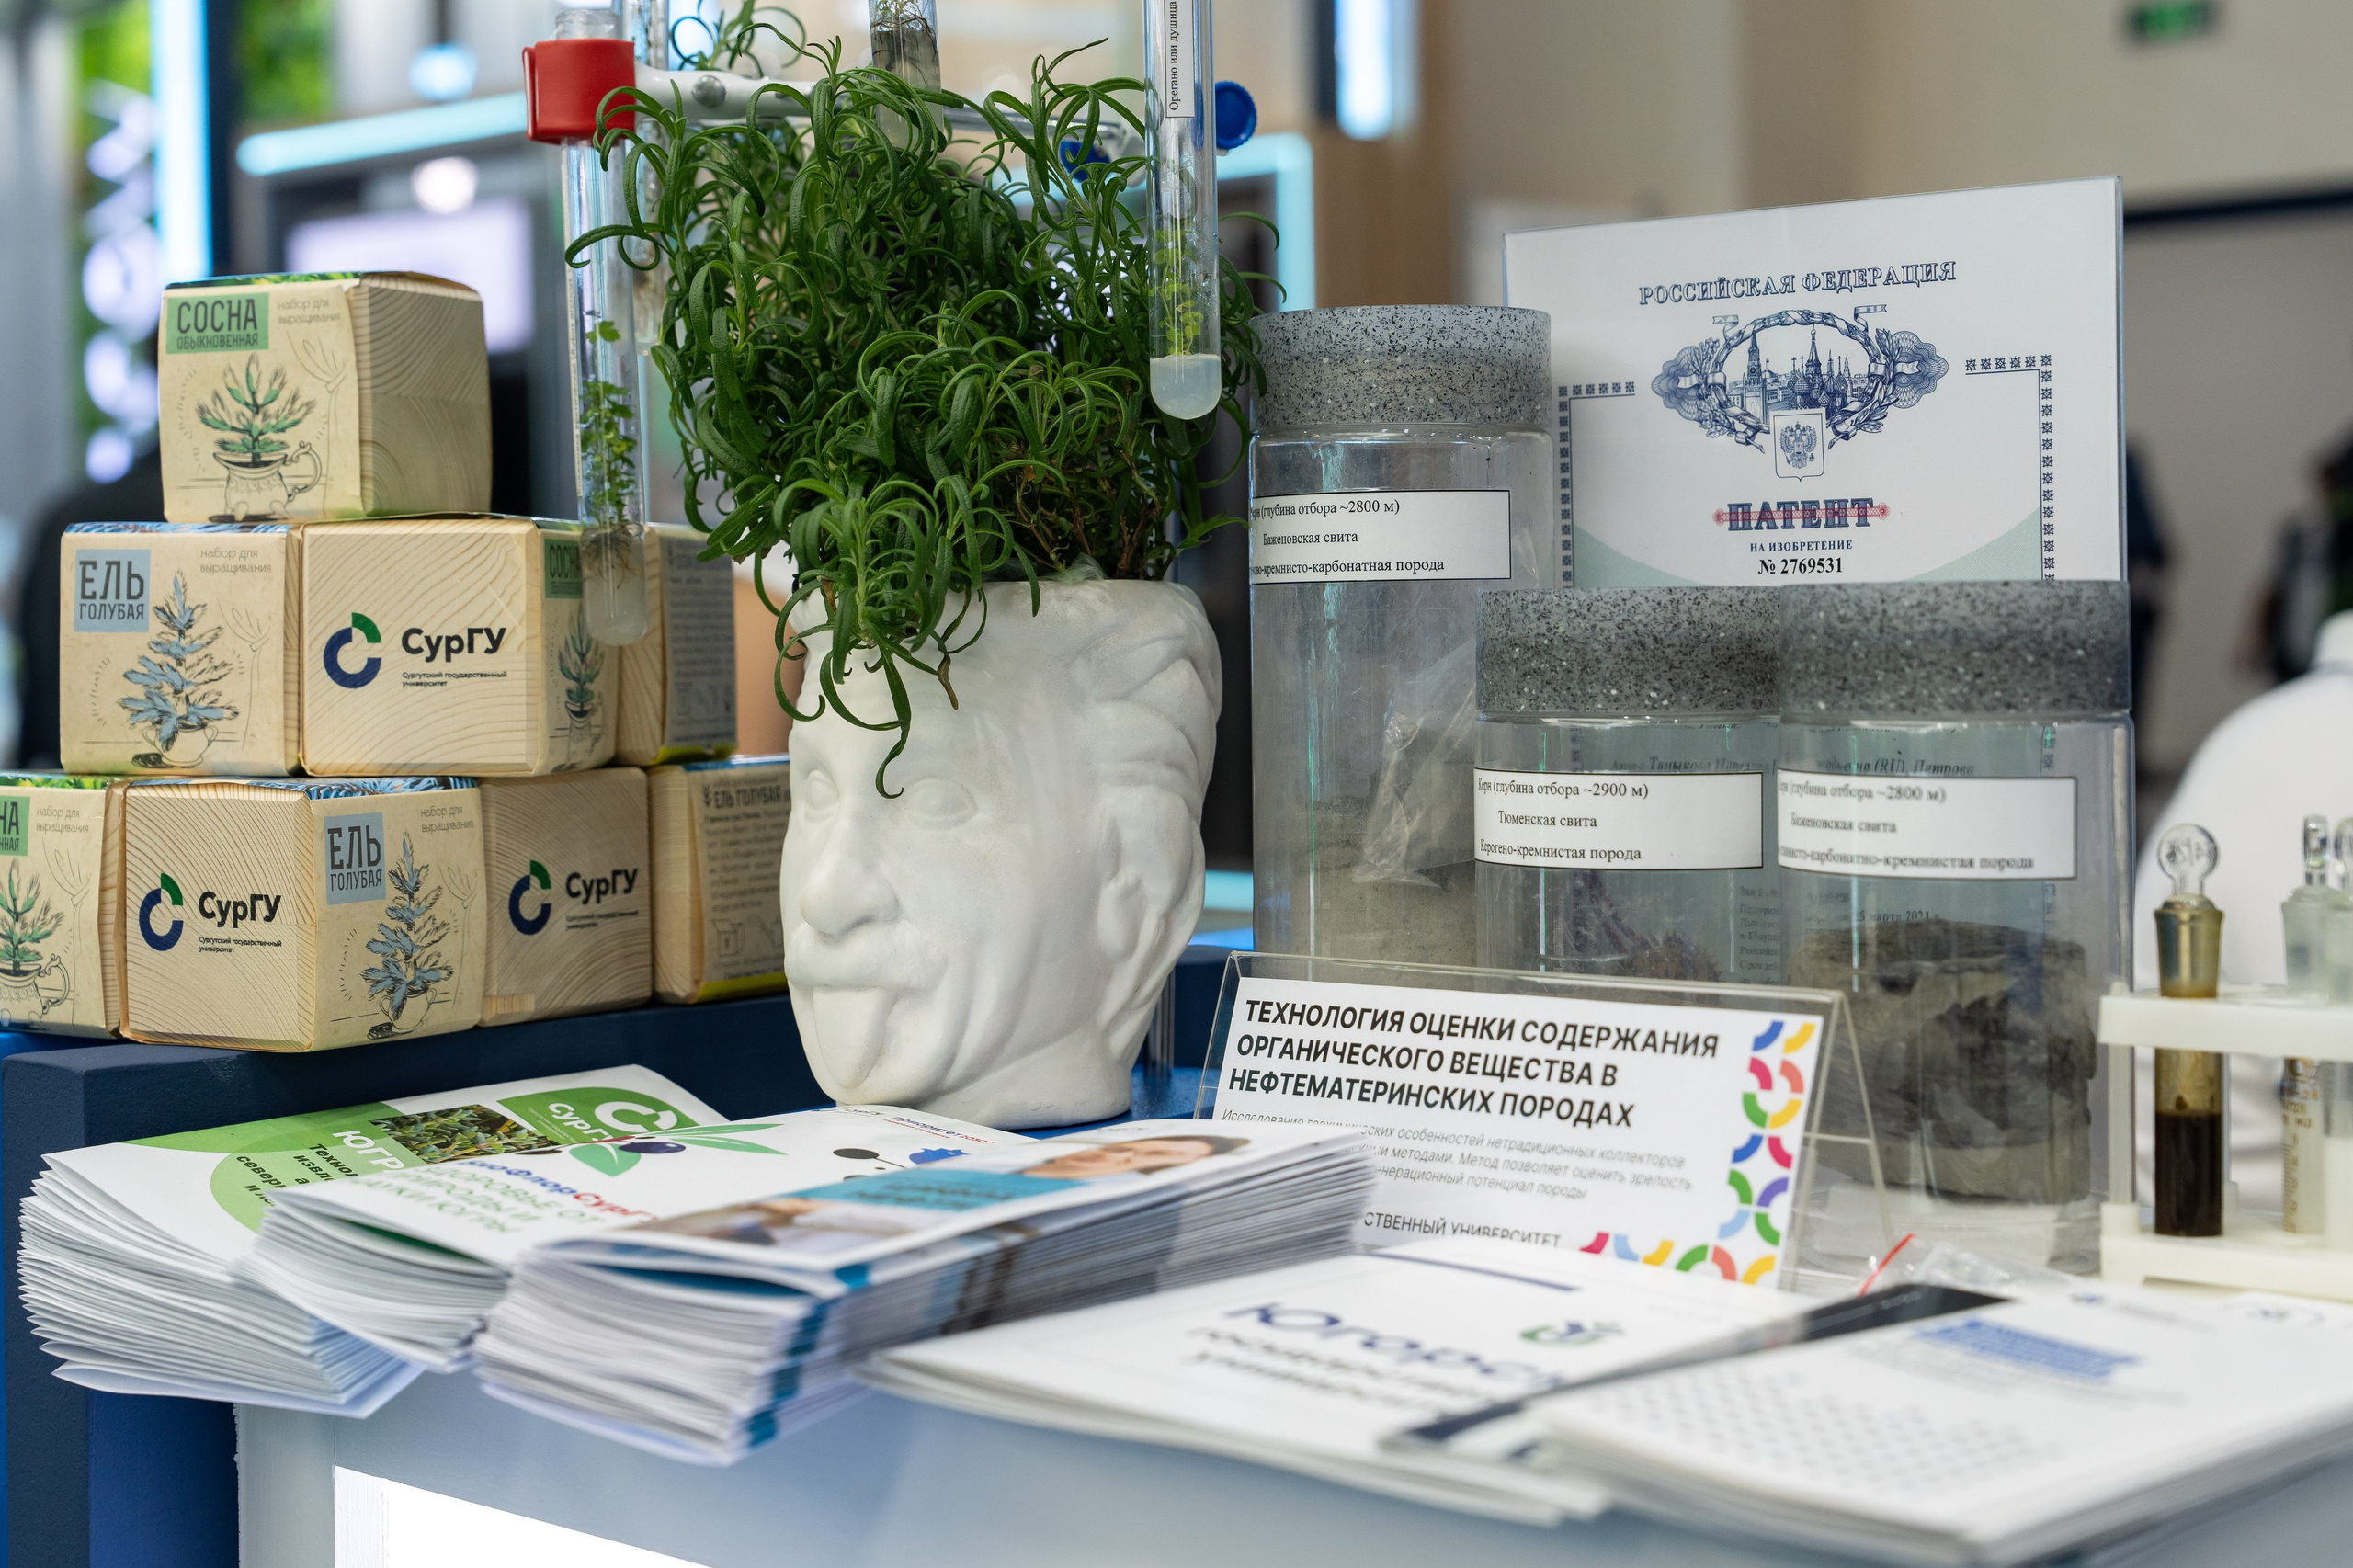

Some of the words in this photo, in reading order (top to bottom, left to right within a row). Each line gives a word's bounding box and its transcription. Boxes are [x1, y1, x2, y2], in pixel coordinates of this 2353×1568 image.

[1170, 1, 1180, 42] душица
[1170, 44, 1178, 65] или
[1168, 67, 1180, 110] Орегано
[1639, 276, 1796, 305] РОССИЙСКАЯ
[1802, 261, 1956, 294] ФЕДЕРАЦИЯ
[176, 298, 258, 334] СОСНА
[278, 299, 311, 312] набор
[313, 299, 329, 311] для
[278, 312, 341, 325] выращивания
[176, 332, 258, 350] ОБЫКНОВЕННАЯ
[1261, 504, 1296, 520] (глубина
[1298, 501, 1336, 518] отбора
[1339, 499, 1380, 514] ~2800
[1383, 499, 1401, 516] м)
[1727, 497, 1874, 531] ПАТЕНТ
[1263, 532, 1321, 546] Баженовская
[1324, 531, 1358, 544] свита
[1750, 542, 1766, 552] НА
[1768, 540, 1853, 552] ИЗОБРЕТЕНИЕ
[200, 546, 236, 562] набор
[238, 550, 258, 561] для
[199, 562, 272, 575] выращивания
[1395, 560, 1445, 574] порода
[1757, 559, 1776, 574] №
[1780, 557, 1843, 574] 2769531
[79, 560, 145, 600] ЕЛЬ
[79, 603, 145, 620] ГОЛУБАЯ
[401, 627, 507, 663] СурГУ
[1477, 778, 1492, 795] Керн
[1493, 778, 1534, 797] (глубина
[1537, 780, 1580, 799] отбора
[1583, 783, 1627, 797] ~2900
[1631, 783, 1649, 800] м)
[1829, 782, 1873, 802] отбора
[36, 805, 64, 820] набор
[64, 809, 80, 821] для
[420, 805, 448, 819] набор
[449, 805, 463, 818] для
[1498, 810, 1556, 827] Тюменская
[1560, 815, 1597, 828] свита
[1790, 812, 1854, 831] Баженовская
[1857, 820, 1897, 834] свита
[35, 822, 89, 835] выращивания
[421, 819, 474, 834] выращивания
[327, 824, 381, 870] ЕЛЬ
[1480, 838, 1586, 859] Керогено-кремнистая
[1590, 846, 1642, 863] порода
[1979, 856, 2034, 872] порода
[330, 869, 383, 892] ГОЛУБАЯ
[565, 868, 639, 905] СурГУ
[198, 891, 282, 929] СурГУ
[1245, 999, 1405, 1033] ТЕХНОЛОГИЯ
[1409, 1011, 1516, 1042] ОЦЕНКИ
[1521, 1020, 1719, 1058] СОДЕРЖАНИЯ
[1237, 1033, 1445, 1072] ОРГАНИЧЕСКОГО
[1449, 1051, 1593, 1085] ВЕЩЕСТВА
[1601, 1063, 1618, 1087] В
[1228, 1068, 1495, 1114] НЕФТЕМАТЕРИНСКИХ
[1499, 1093, 1635, 1129] ПОРОДАХ
[332, 1130, 405, 1174] ЮГР
[1397, 1128, 1485, 1146] особенностей
[1486, 1137, 1596, 1159] нетрадиционных
[1598, 1148, 1687, 1169] коллекторов
[292, 1154, 335, 1182] извл
[1391, 1146, 1454, 1165] методами.
[1458, 1152, 1499, 1170] Метод
[1502, 1159, 1570, 1176] позволяет
[1572, 1166, 1626, 1184] оценить
[1466, 1175, 1534, 1193] потенциал
[1536, 1182, 1586, 1199] породы
